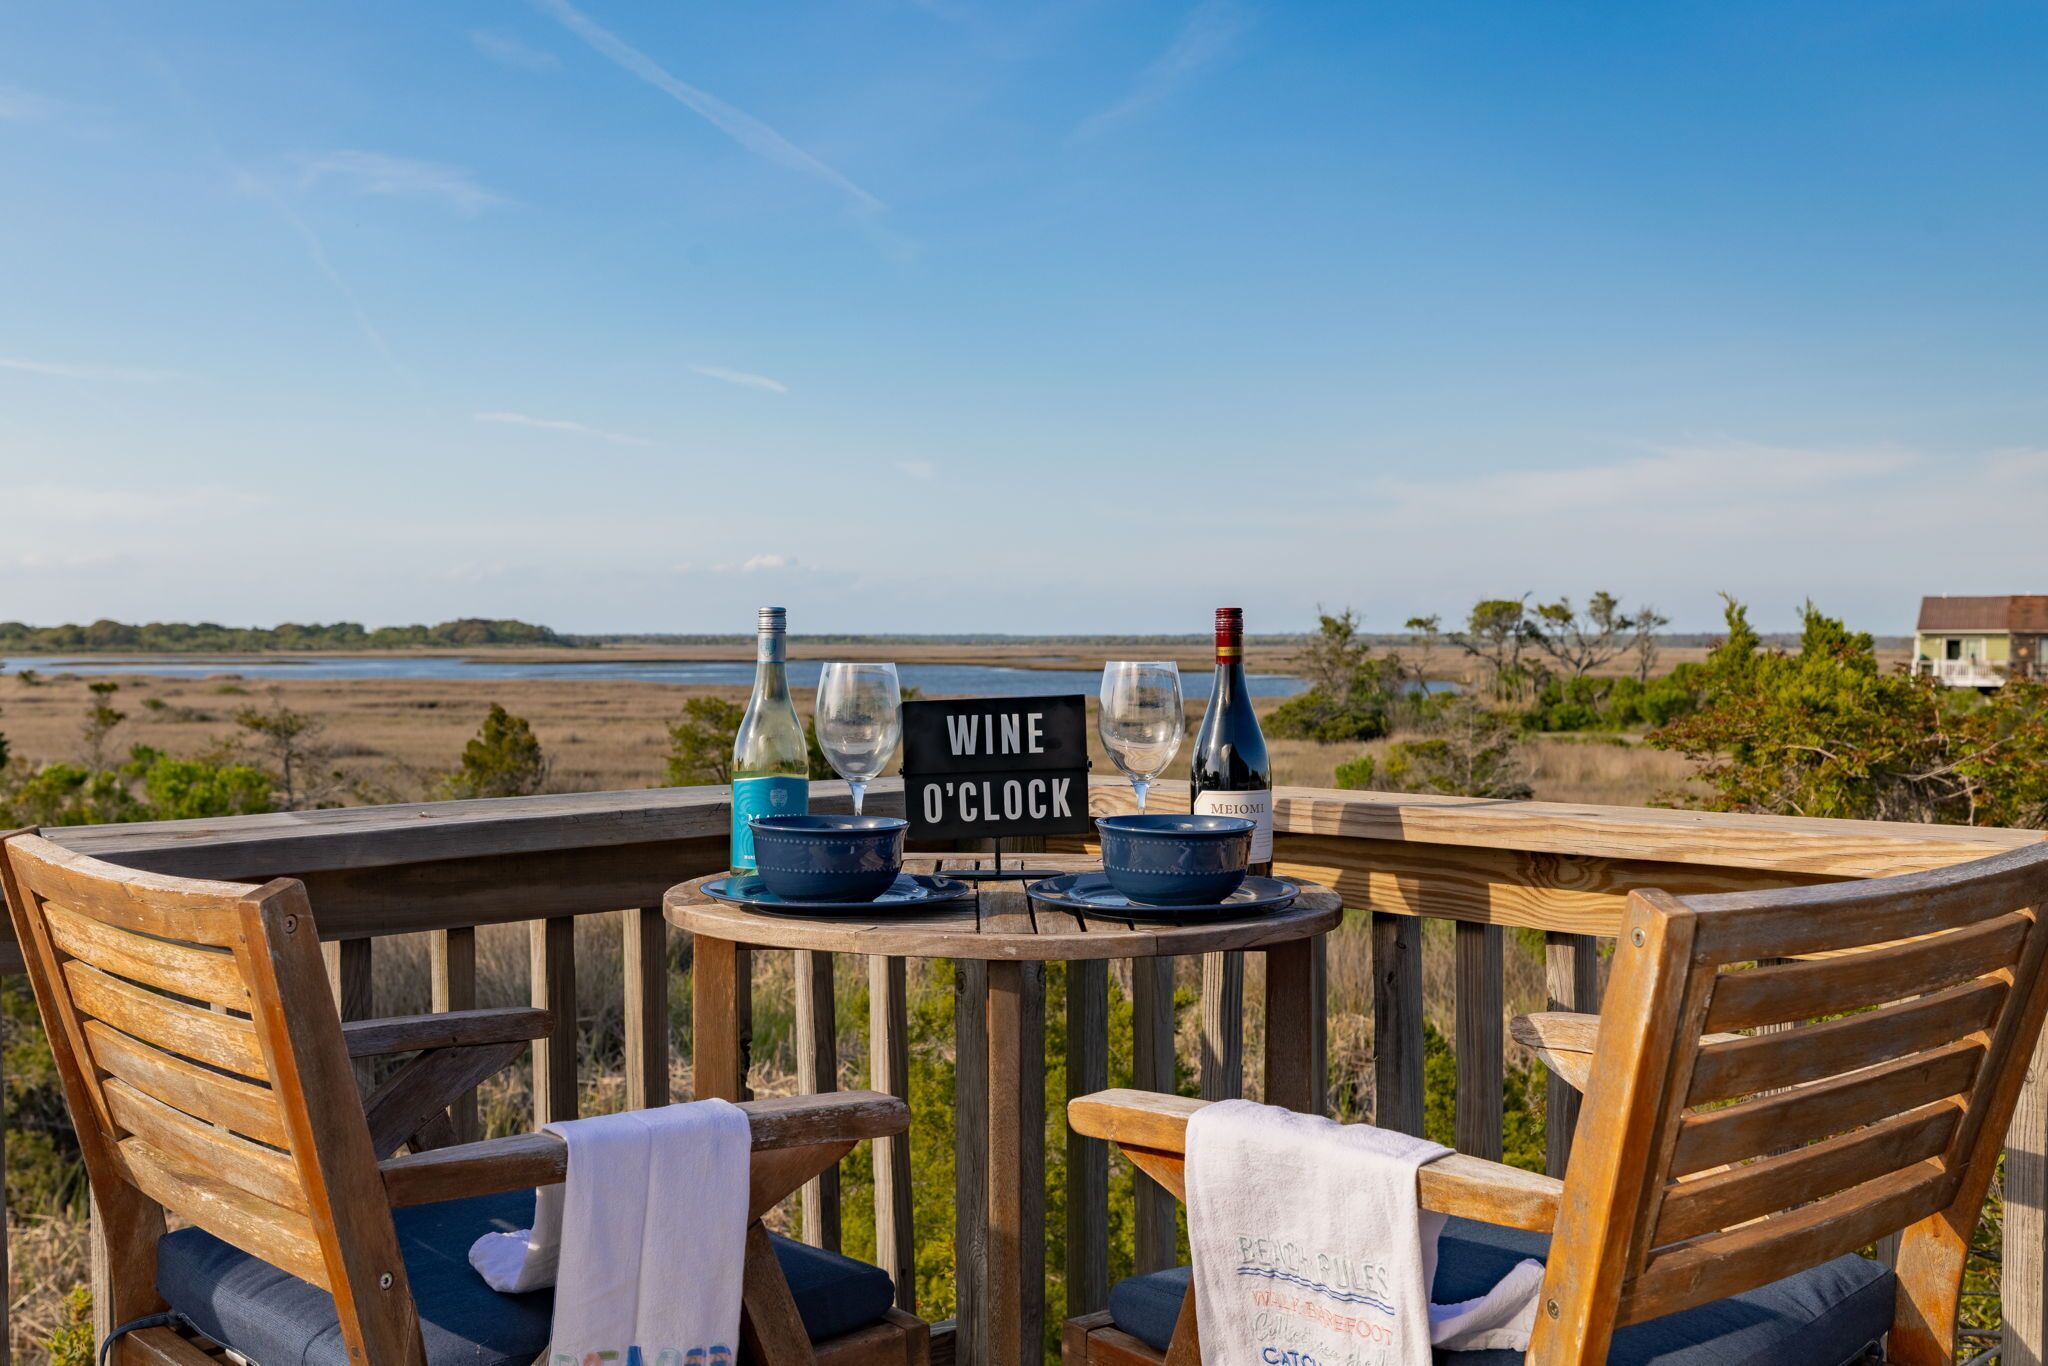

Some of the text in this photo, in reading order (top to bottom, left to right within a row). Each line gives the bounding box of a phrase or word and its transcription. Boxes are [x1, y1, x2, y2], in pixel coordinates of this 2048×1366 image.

[946, 712, 1045, 756] WINE
[922, 777, 1073, 824] O'CLOCK
[1211, 803, 1265, 815] MEIOMI
